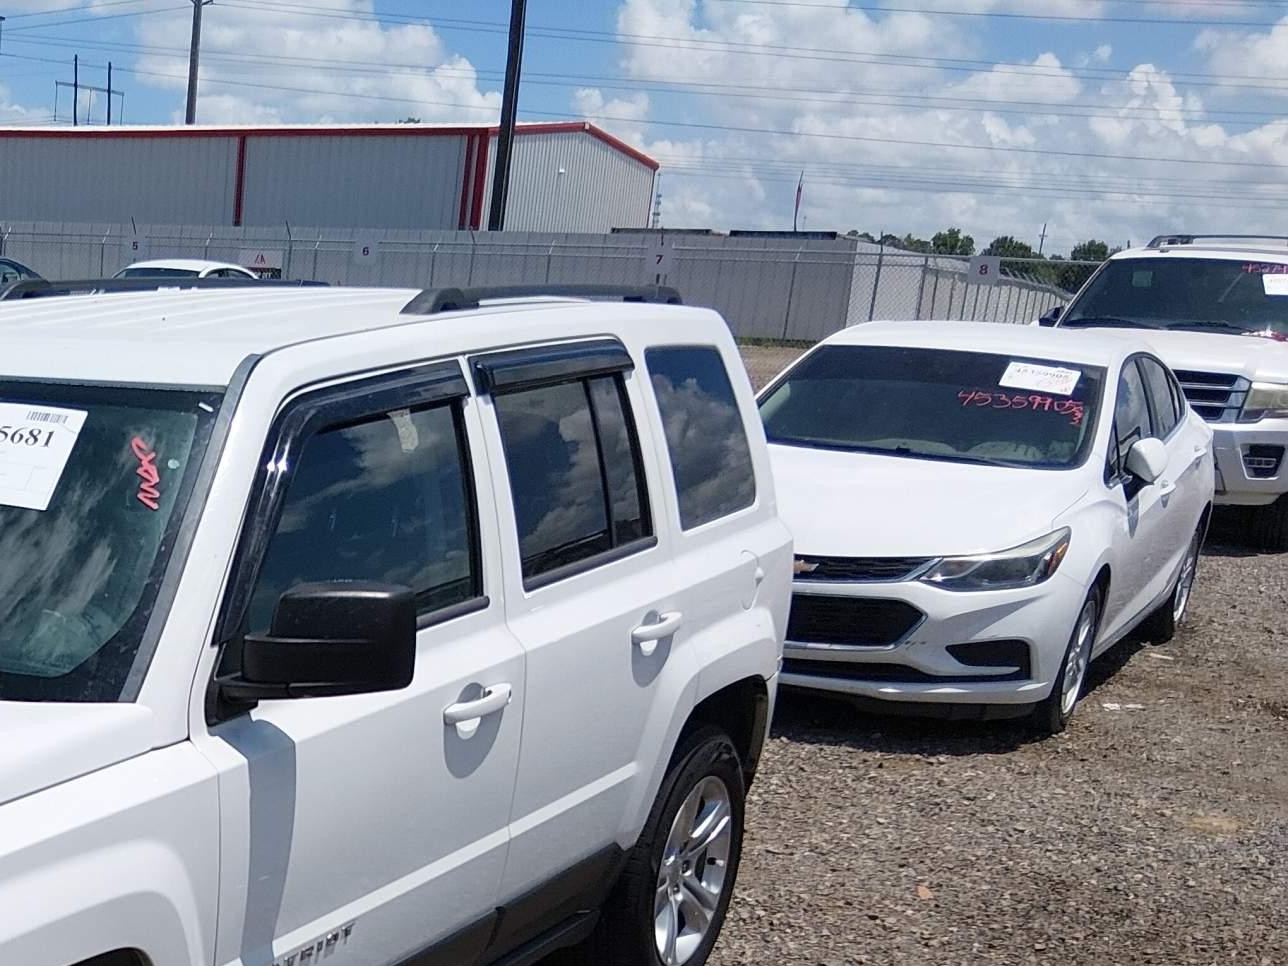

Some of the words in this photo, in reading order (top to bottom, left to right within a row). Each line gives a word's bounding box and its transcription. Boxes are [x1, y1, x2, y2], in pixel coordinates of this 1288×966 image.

[132, 241, 138, 250] 5
[362, 247, 369, 256] 6
[655, 255, 663, 265] 7
[978, 265, 988, 275] 8
